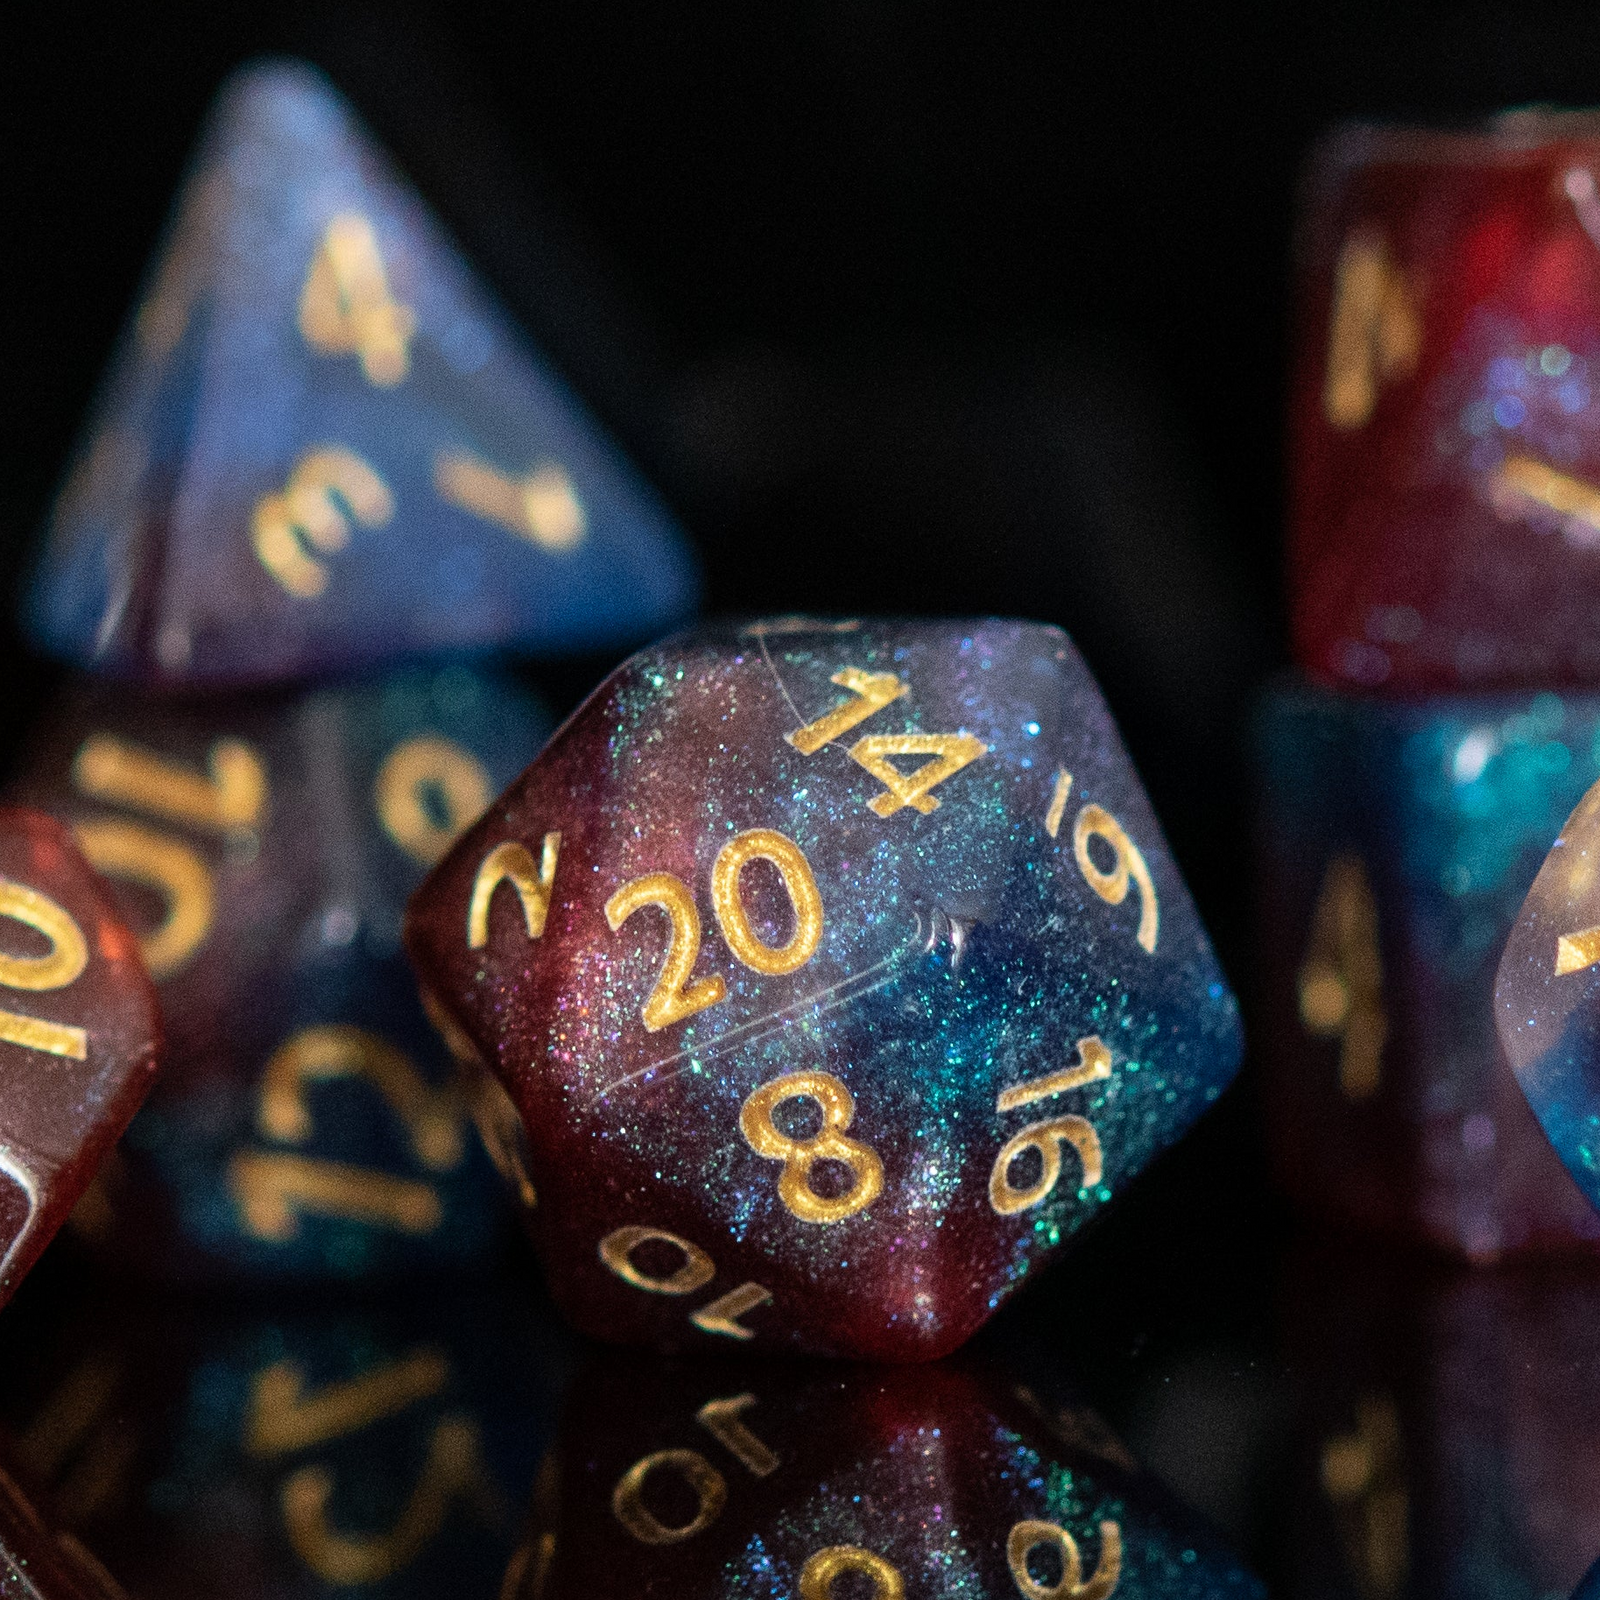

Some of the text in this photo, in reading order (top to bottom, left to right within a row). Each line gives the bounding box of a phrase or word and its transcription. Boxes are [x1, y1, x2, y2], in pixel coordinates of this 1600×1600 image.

[784, 667, 989, 819] 14
[468, 831, 562, 949] 2
[604, 828, 824, 1032] 20
[739, 1070, 885, 1225] 8
[990, 1036, 1112, 1215] 16
[598, 1225, 773, 1340] 10
